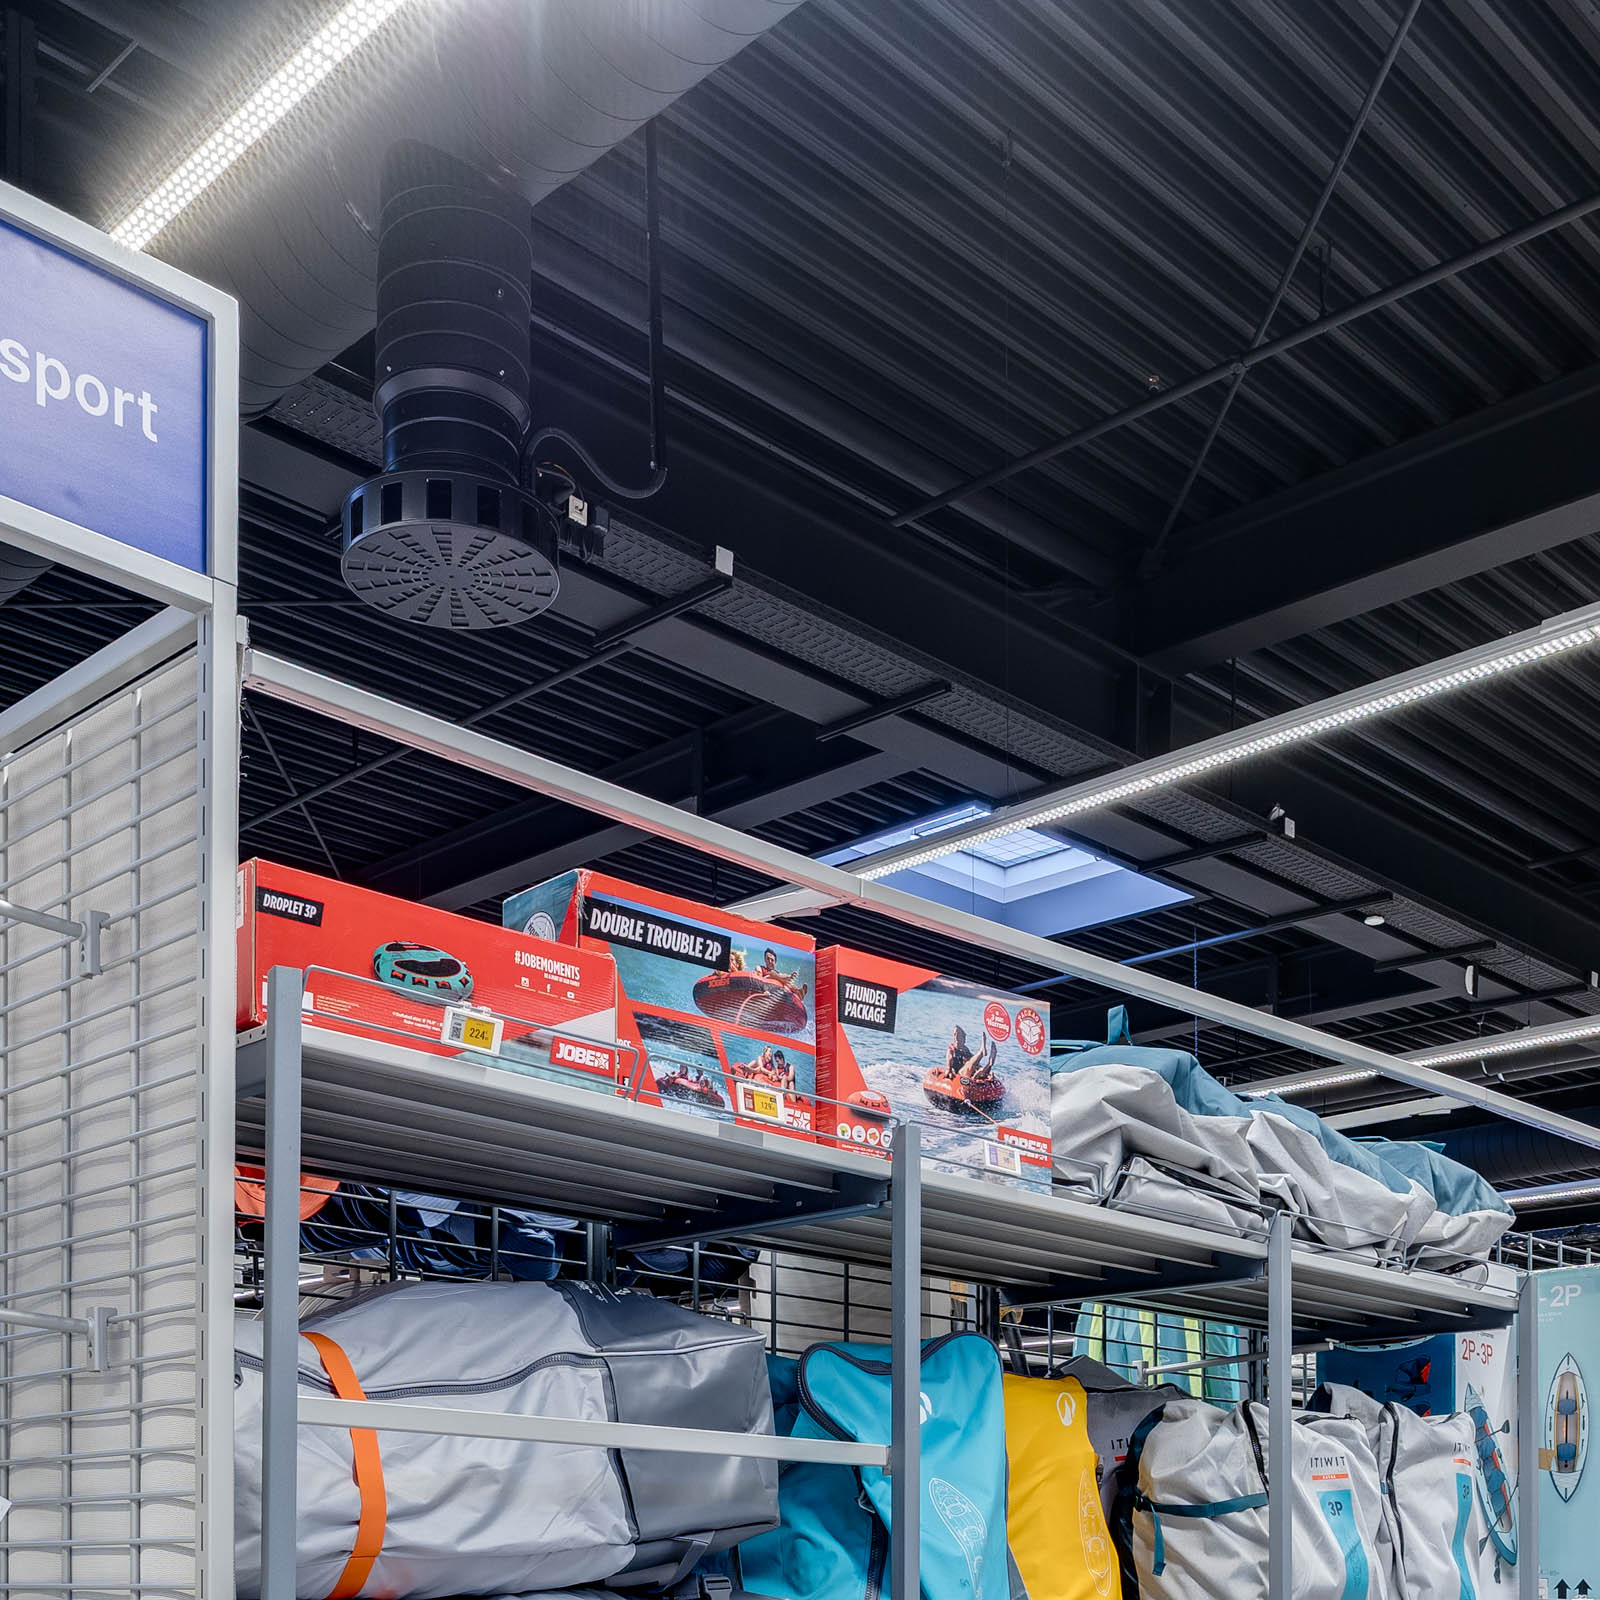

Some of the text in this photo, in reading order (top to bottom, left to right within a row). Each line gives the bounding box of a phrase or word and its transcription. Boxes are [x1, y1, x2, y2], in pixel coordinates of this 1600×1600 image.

[262, 893, 317, 918] DROPLET 3P
[590, 908, 722, 962] DOUBLE TROUBLE 2P
[514, 950, 581, 980] #JOBEMOMENTS
[845, 983, 888, 1007] THUNDER
[844, 1002, 887, 1025] PACKAGE
[1310, 1455, 1346, 1469] ITIWIT
[1328, 1500, 1343, 1517] 3P
